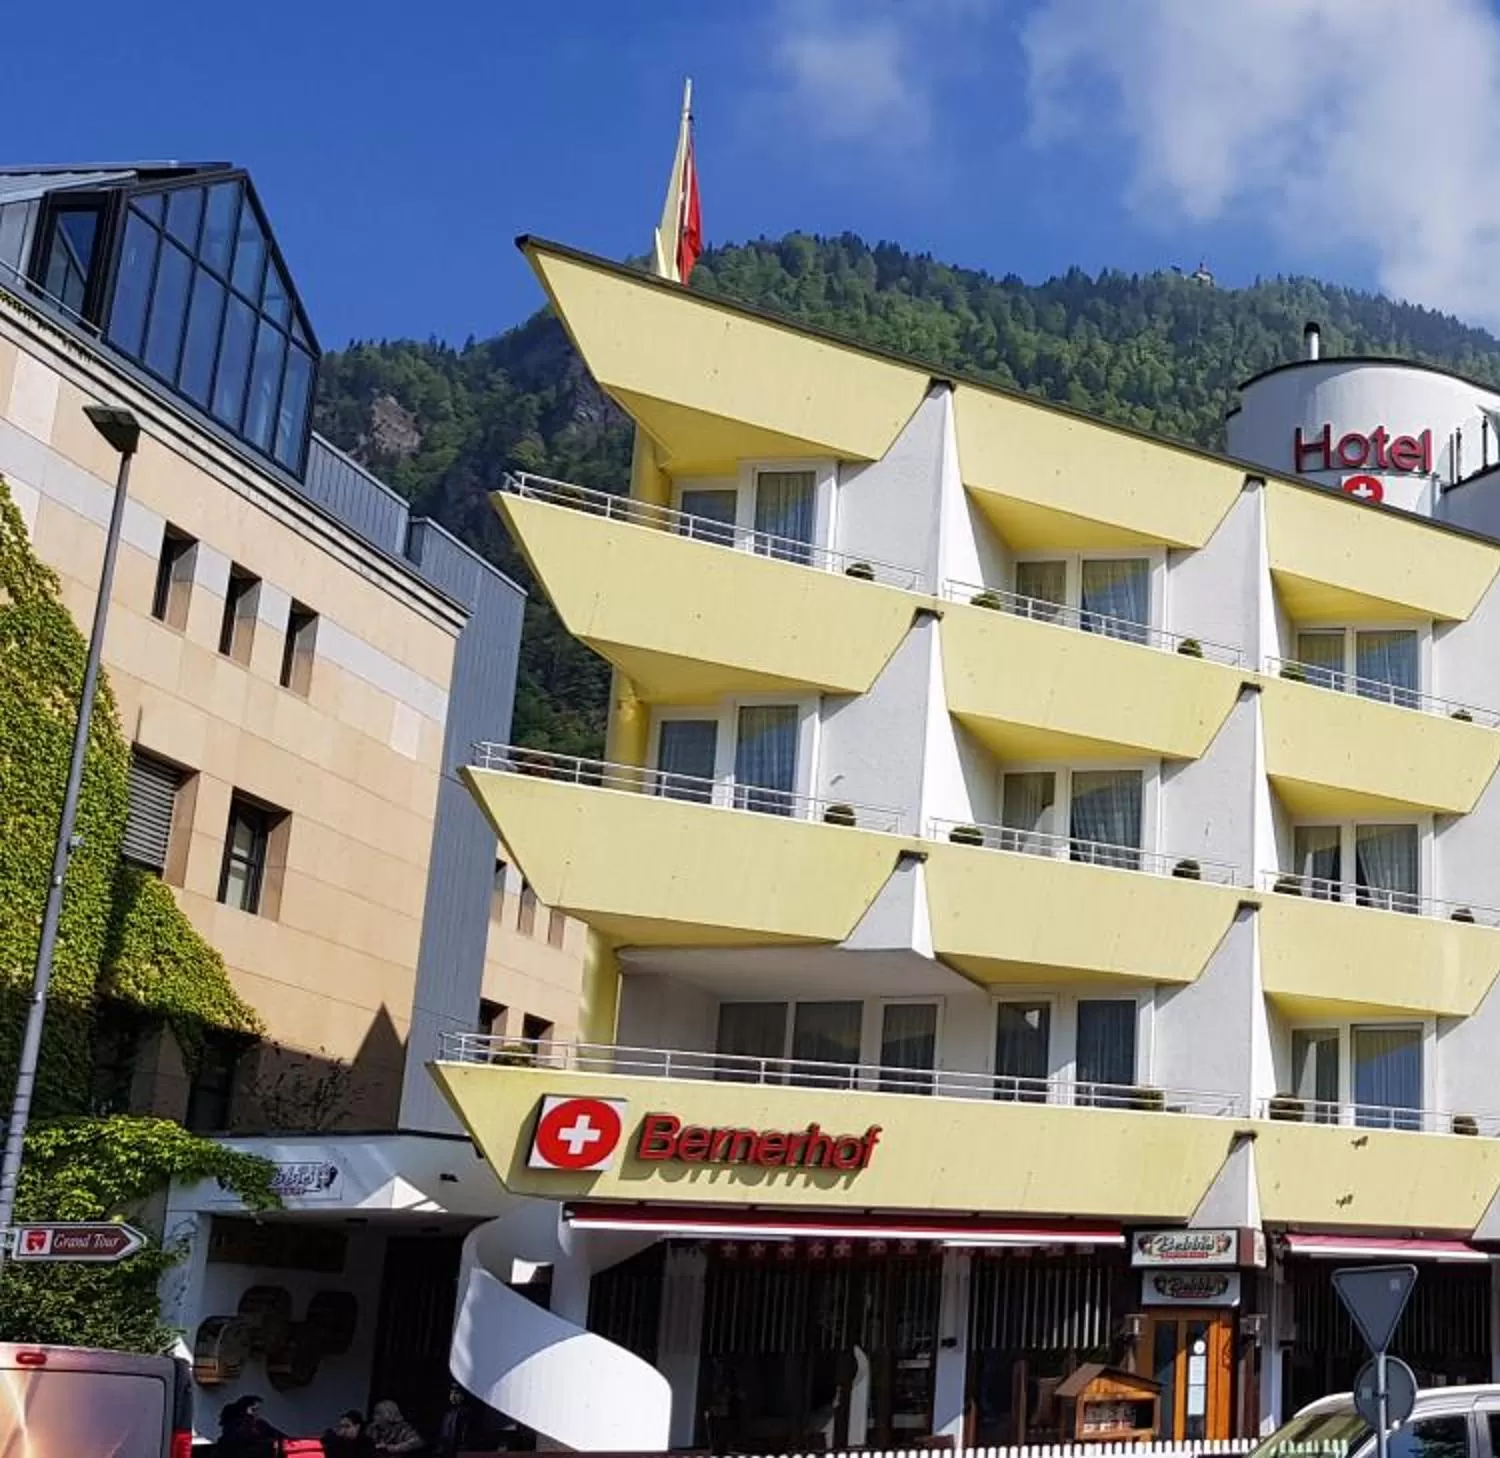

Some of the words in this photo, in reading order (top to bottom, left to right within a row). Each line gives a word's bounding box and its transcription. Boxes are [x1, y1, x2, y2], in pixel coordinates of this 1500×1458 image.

[1295, 424, 1433, 474] Hotel
[638, 1113, 883, 1170] Bernerhof
[53, 1232, 91, 1248] Grand
[93, 1233, 119, 1248] Tour
